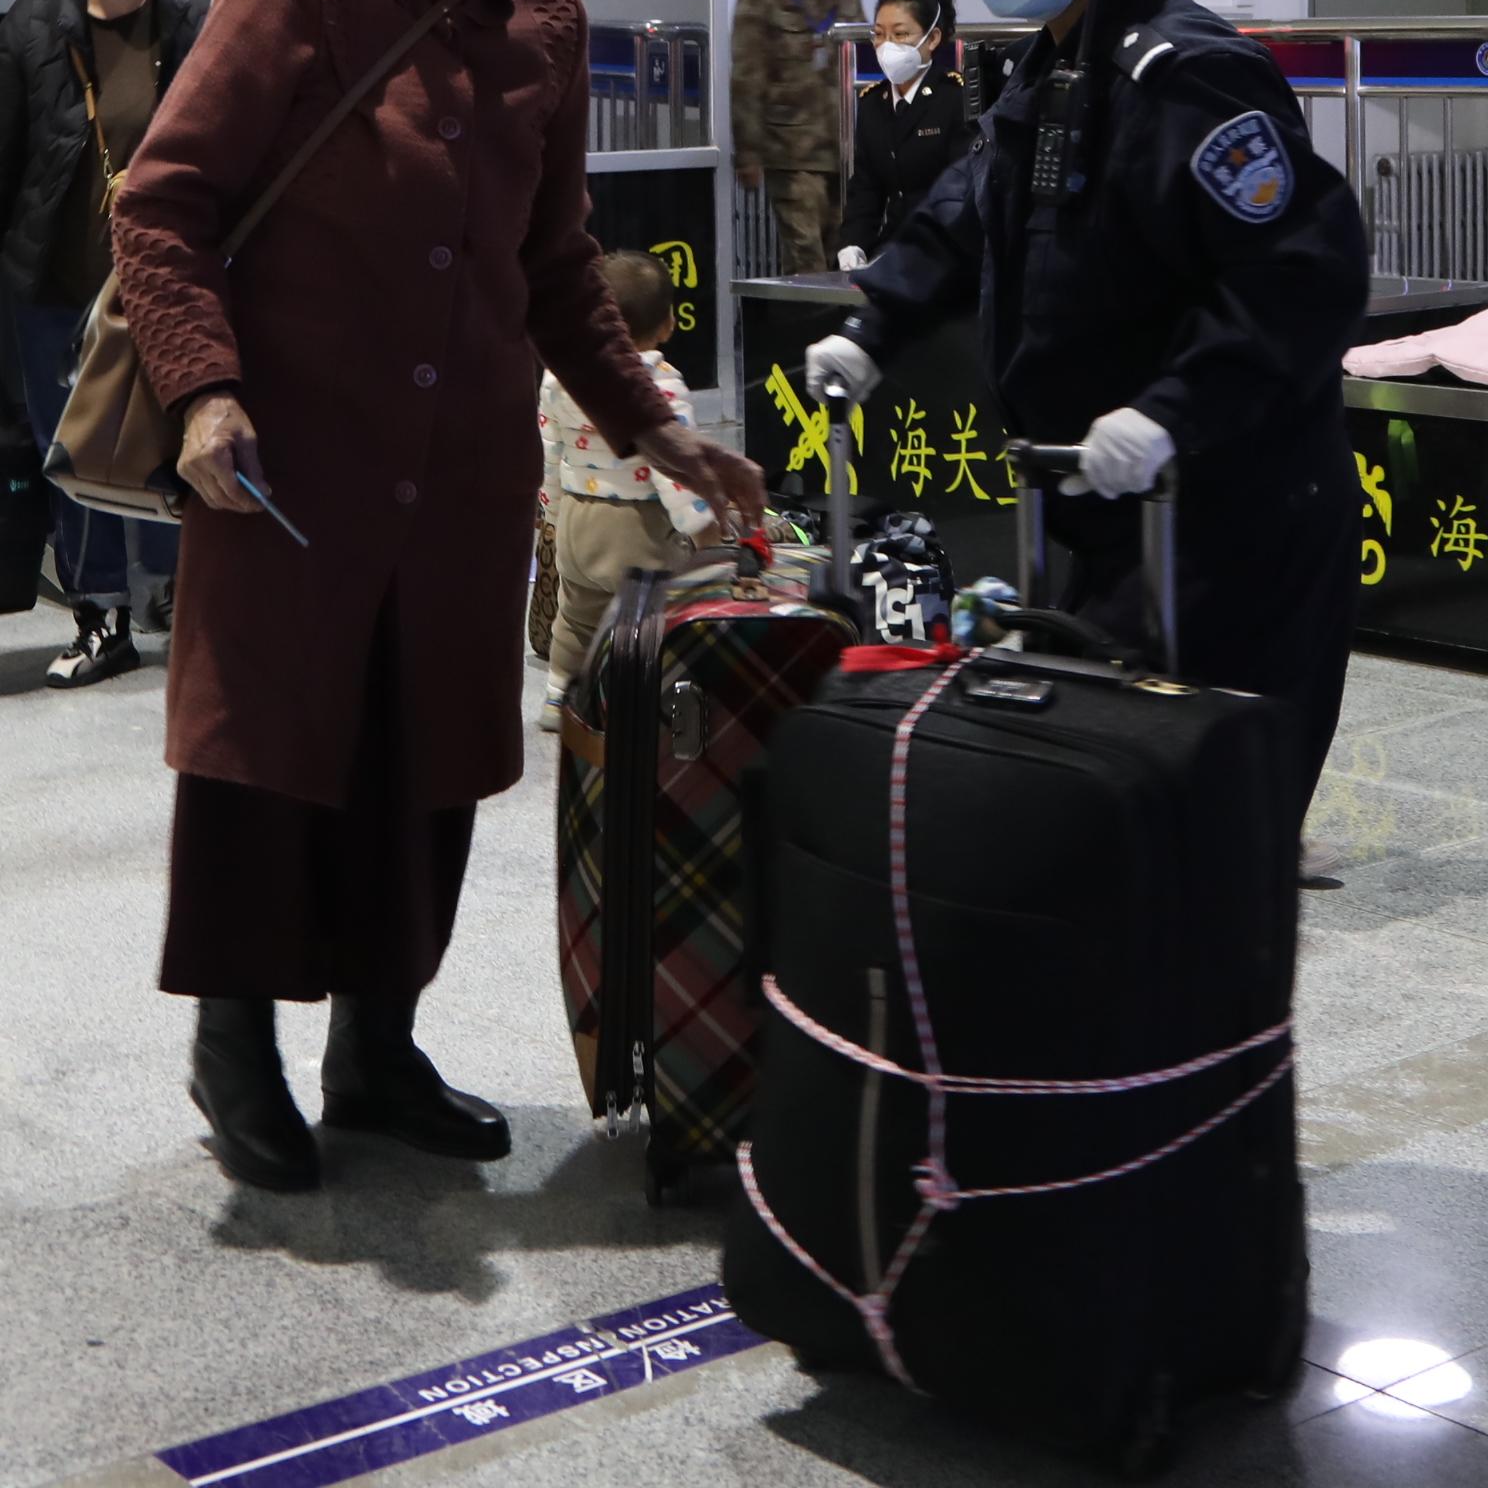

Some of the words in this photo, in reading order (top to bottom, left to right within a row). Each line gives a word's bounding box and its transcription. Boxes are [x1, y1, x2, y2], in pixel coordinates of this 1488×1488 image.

[418, 1337, 607, 1402] NSPECTION
[452, 1338, 702, 1426] 检区域
